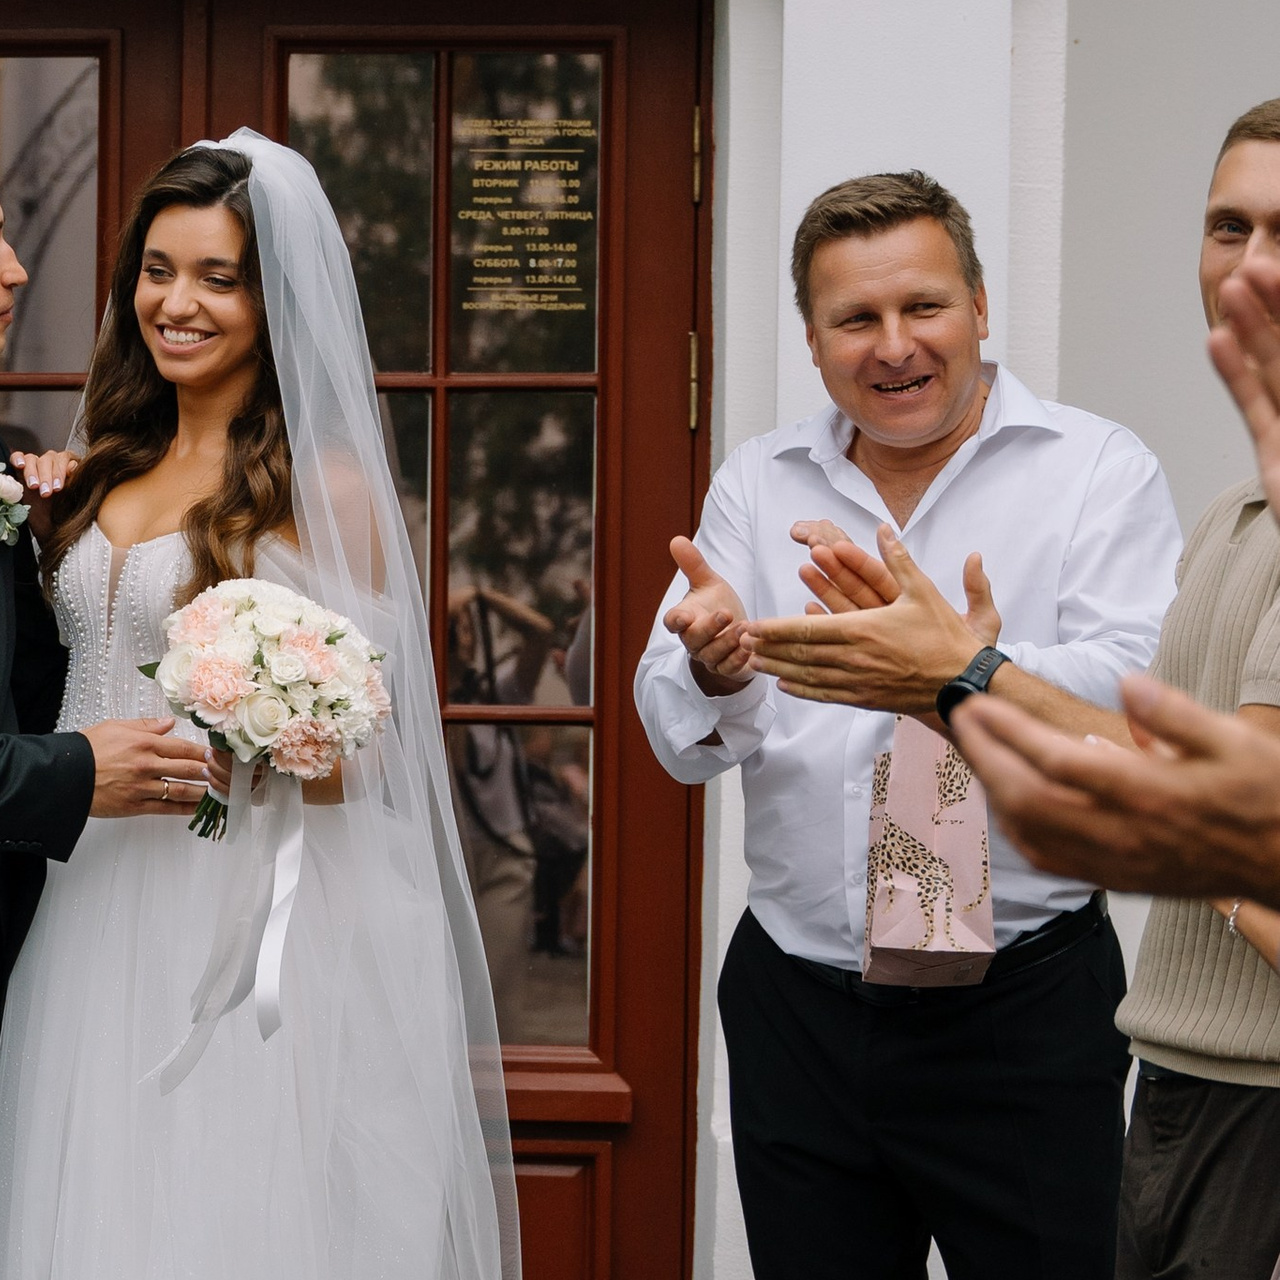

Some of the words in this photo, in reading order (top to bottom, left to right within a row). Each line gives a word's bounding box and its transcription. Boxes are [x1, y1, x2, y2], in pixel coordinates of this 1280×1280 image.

[474, 160, 521, 171] РЕЖИМ
[524, 160, 579, 171] РАБОТЫ
[472, 179, 519, 188] ВТОРНИК
[545, 211, 593, 221] ПЯТНИЦА
[473, 258, 520, 268] СУББОТА
